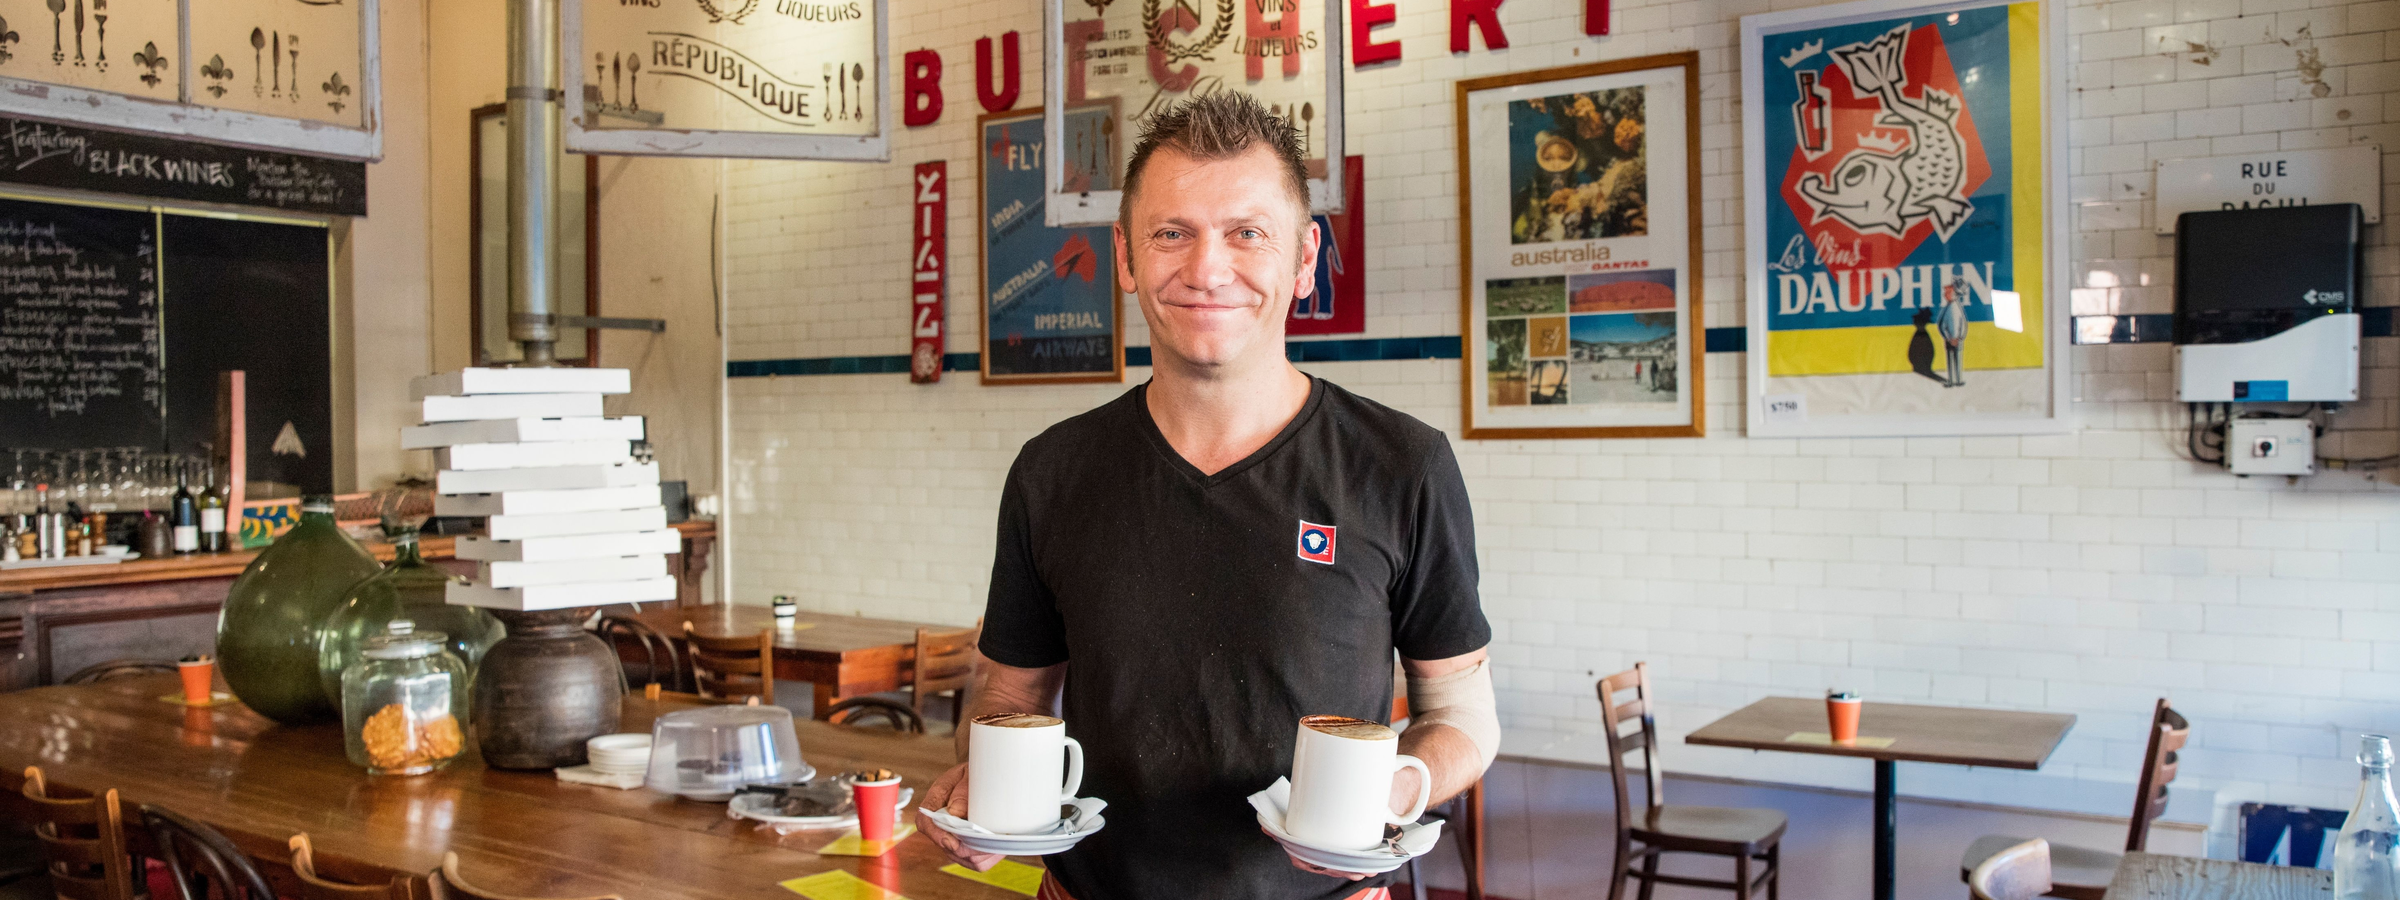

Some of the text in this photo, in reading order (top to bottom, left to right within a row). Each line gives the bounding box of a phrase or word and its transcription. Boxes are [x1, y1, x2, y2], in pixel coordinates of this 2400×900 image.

[776, 0, 862, 22] LIQUEURS
[1232, 30, 1318, 58] LIQUEURS
[652, 38, 810, 118] RÉPUBLIQUE
[89, 149, 234, 188] BLACK WINES
[1007, 141, 1043, 172] FLY
[2241, 160, 2287, 179] RUE
[2253, 182, 2275, 195] DU
[991, 199, 1025, 229] INDIA
[1511, 242, 1611, 267] australia
[1768, 230, 1866, 272] Les Vins
[1591, 260, 1650, 271] QANTAS
[991, 259, 1048, 305] AUSTRALIA
[1777, 261, 1995, 316] DAUPHIN
[1034, 311, 1103, 331] IMPERIAL
[1032, 338, 1107, 358] AIRWAYS
